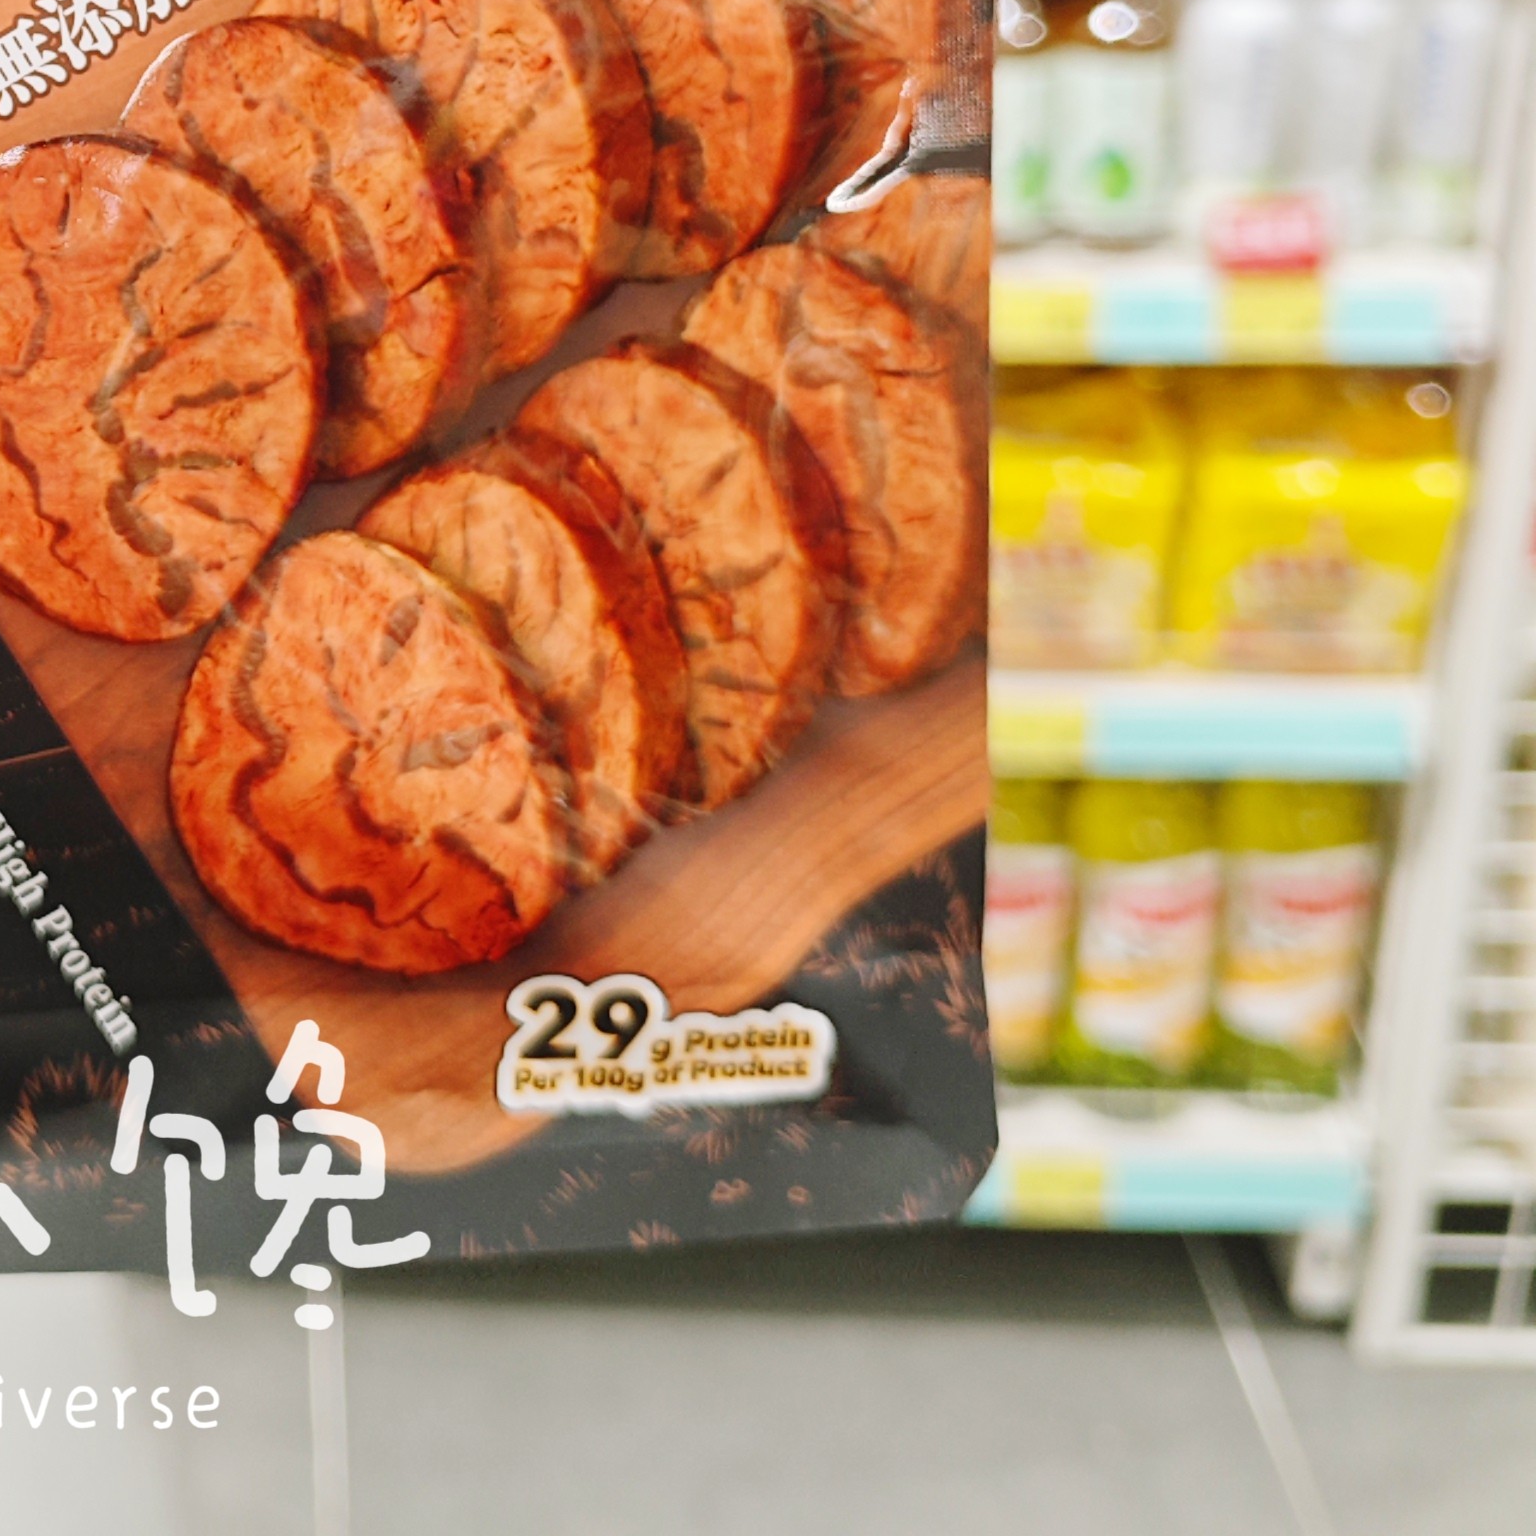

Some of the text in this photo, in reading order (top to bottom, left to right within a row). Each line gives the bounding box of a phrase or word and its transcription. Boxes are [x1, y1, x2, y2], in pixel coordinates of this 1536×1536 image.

[31, 904, 139, 1057] Protein
[685, 1021, 812, 1052] Protein
[515, 1054, 808, 1094] Per 100g of Product
